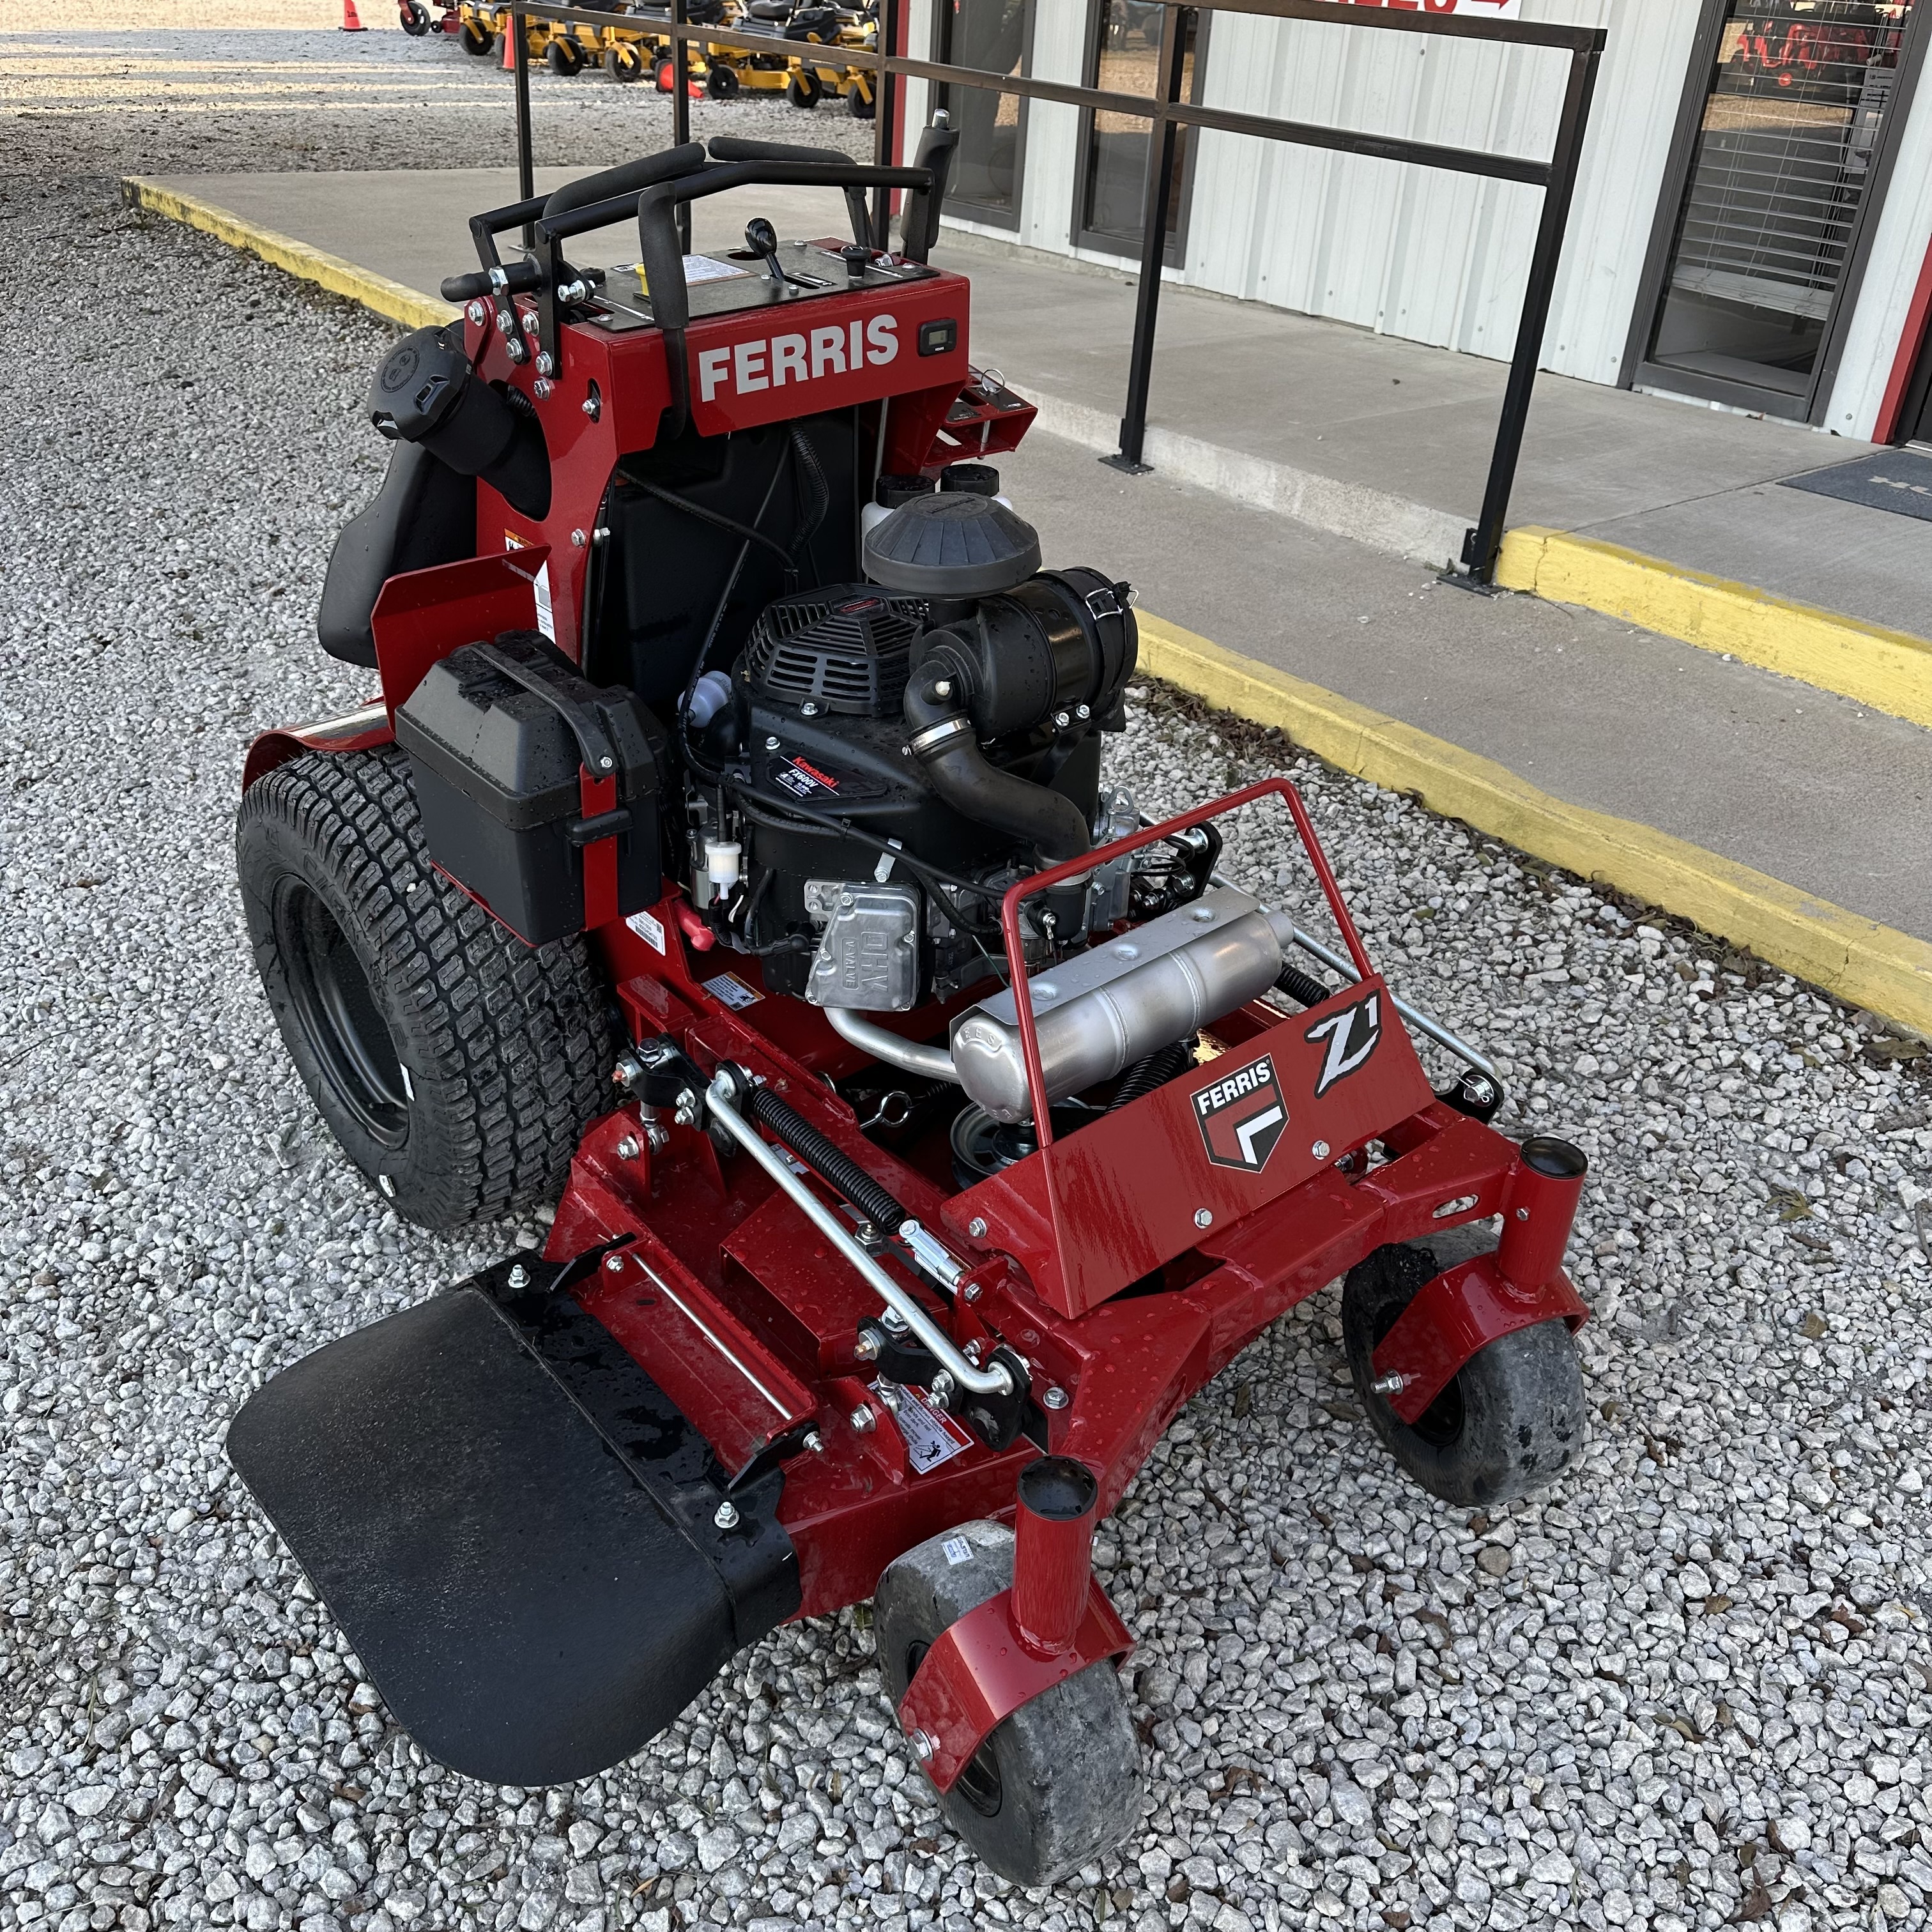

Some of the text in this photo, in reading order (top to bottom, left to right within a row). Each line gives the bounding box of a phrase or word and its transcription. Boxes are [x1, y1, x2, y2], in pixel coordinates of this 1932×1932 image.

[698, 313, 899, 402] FERRIS
[788, 768, 820, 788] FX600V
[792, 756, 840, 788] Kawasaki
[845, 940, 857, 989] V-VALVE
[861, 931, 889, 992] OHV
[1197, 1061, 1272, 1116] FERRIS
